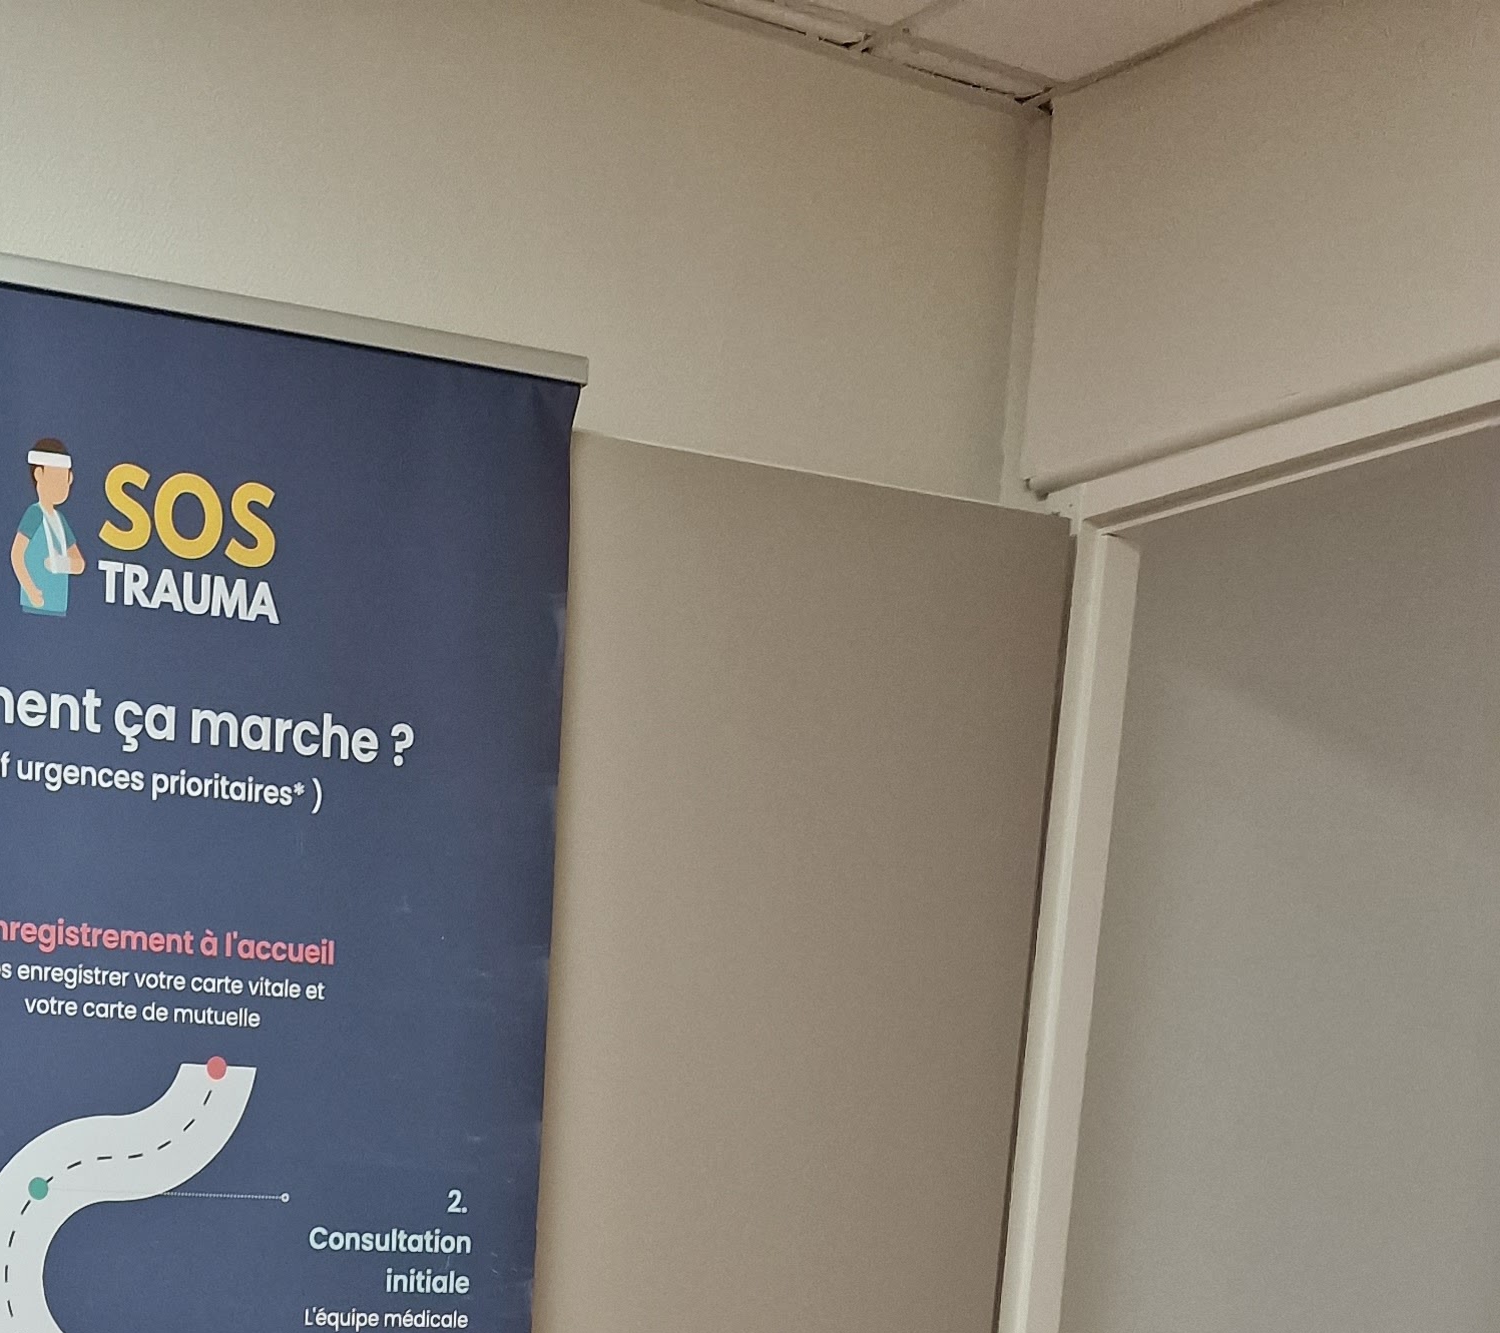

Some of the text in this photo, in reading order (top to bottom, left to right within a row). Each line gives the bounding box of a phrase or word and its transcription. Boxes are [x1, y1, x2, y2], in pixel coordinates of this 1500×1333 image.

[99, 463, 276, 568] SOS
[98, 560, 280, 625] TRAUMA
[114, 700, 175, 753] ça
[190, 707, 378, 763] marche
[390, 723, 414, 767] ?
[17, 757, 144, 792] urgences
[200, 930, 218, 957] à
[224, 930, 335, 966] l'accueil
[17, 962, 129, 990] enregistrer
[134, 968, 186, 992] votre
[190, 972, 244, 995] carte
[248, 974, 301, 999] vitale
[305, 979, 325, 1001] et
[24, 996, 261, 1028] votre carte de mutuelle
[447, 1189, 468, 1213] 2.
[309, 1226, 472, 1254] Consultation
[386, 1268, 470, 1294] initiale
[304, 1308, 468, 1332] L'équipe médicale
